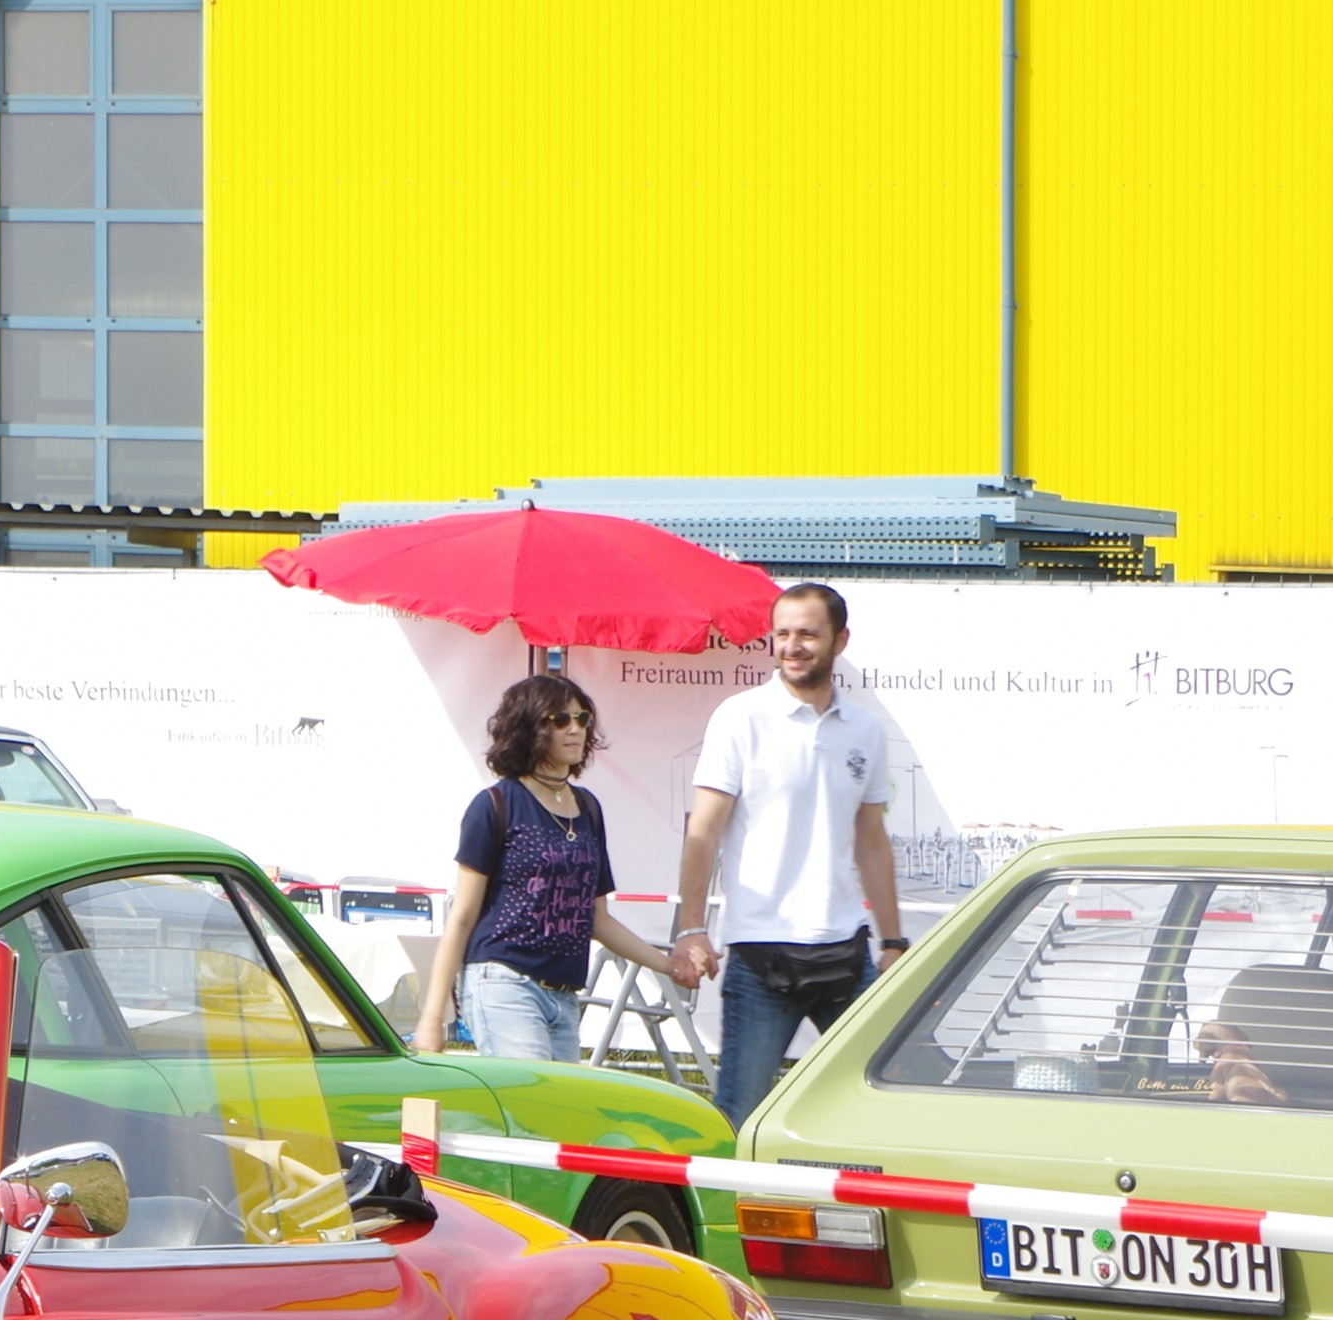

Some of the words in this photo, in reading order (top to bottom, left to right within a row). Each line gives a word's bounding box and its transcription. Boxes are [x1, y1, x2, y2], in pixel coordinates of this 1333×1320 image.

[620, 660, 725, 686] Freiraum
[733, 663, 767, 687] für
[860, 667, 944, 691] Handel
[953, 669, 996, 692] und
[1006, 670, 1084, 694] Kultur
[1093, 671, 1114, 694] in
[1175, 667, 1294, 696] BITBURG
[13, 679, 64, 702] beste
[991, 1251, 1004, 1268] D
[1011, 1223, 1085, 1277] BIT
[1121, 1233, 1177, 1285] ON
